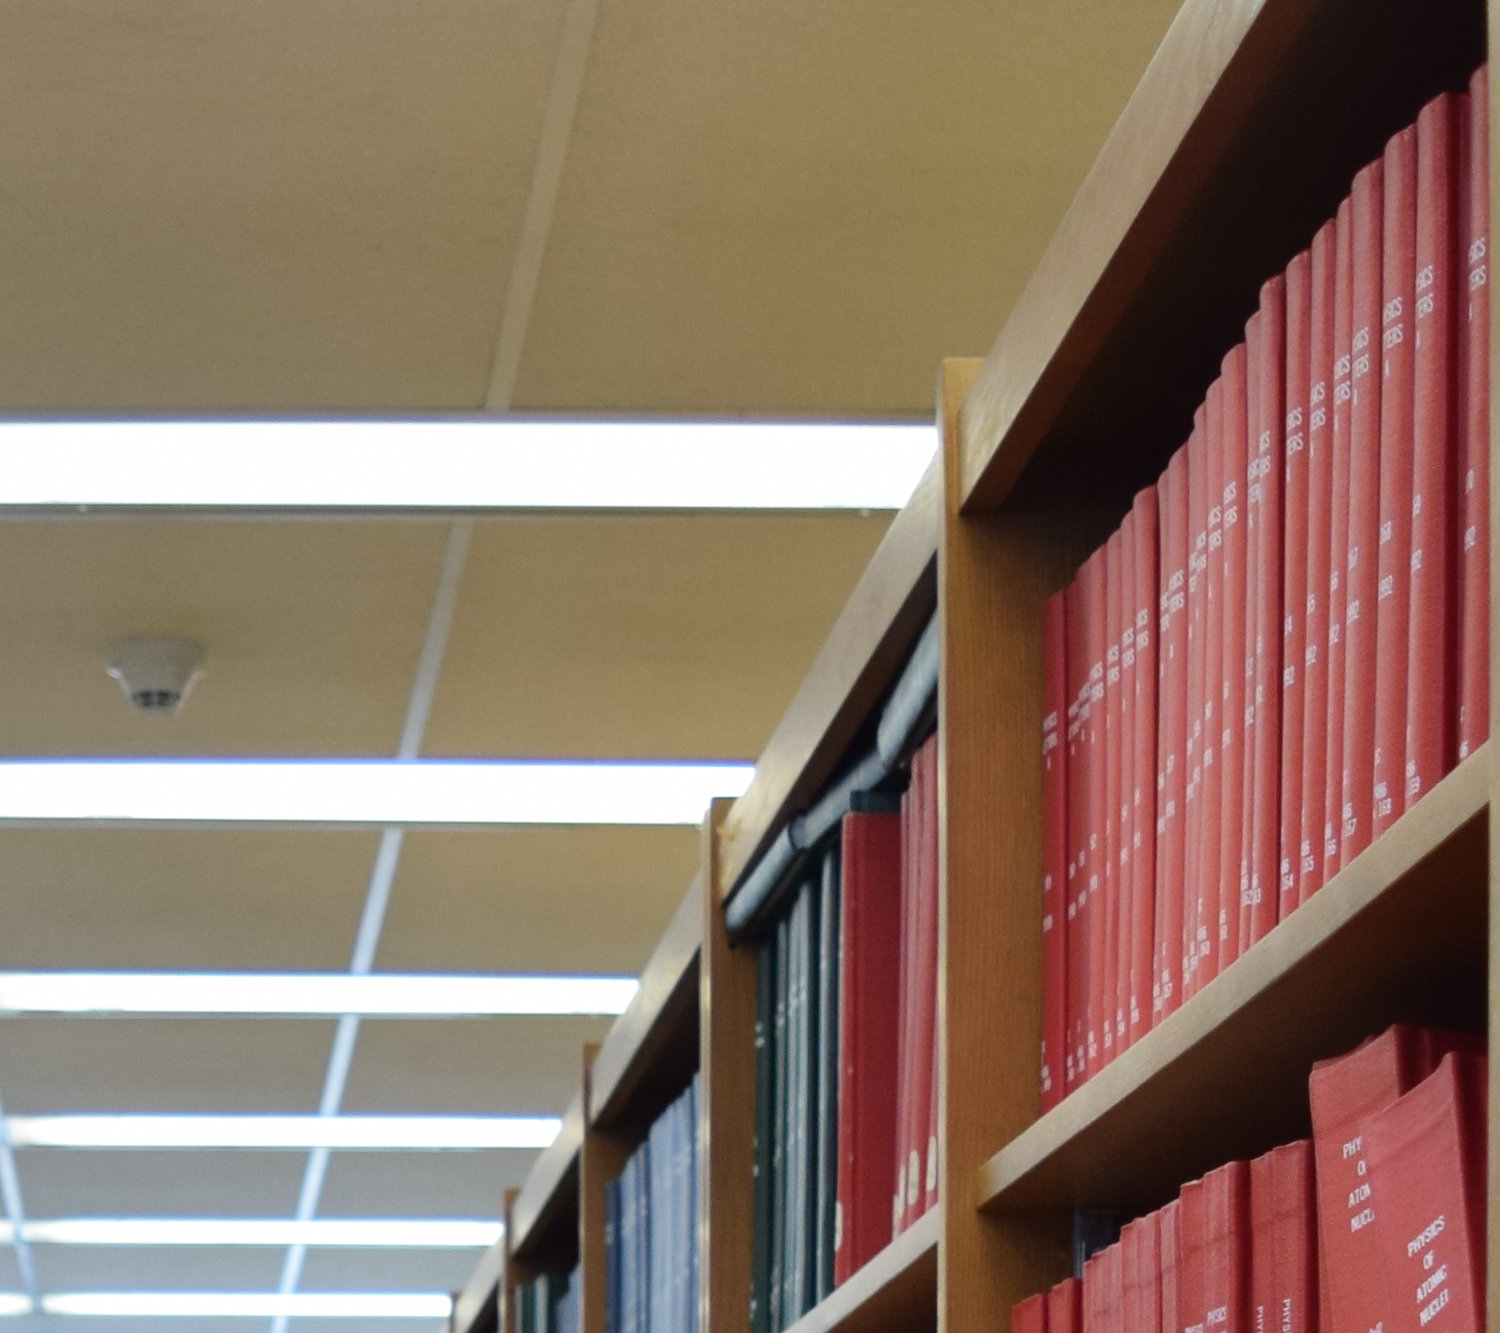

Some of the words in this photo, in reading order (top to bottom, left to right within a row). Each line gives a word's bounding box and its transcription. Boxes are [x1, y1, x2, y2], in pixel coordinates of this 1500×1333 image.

[1407, 1215, 1446, 1257] PHYSICS
[1422, 1249, 1435, 1270] OF
[1416, 1263, 1448, 1304] ATOMIC
[1420, 1288, 1450, 1327] NUCLEI
